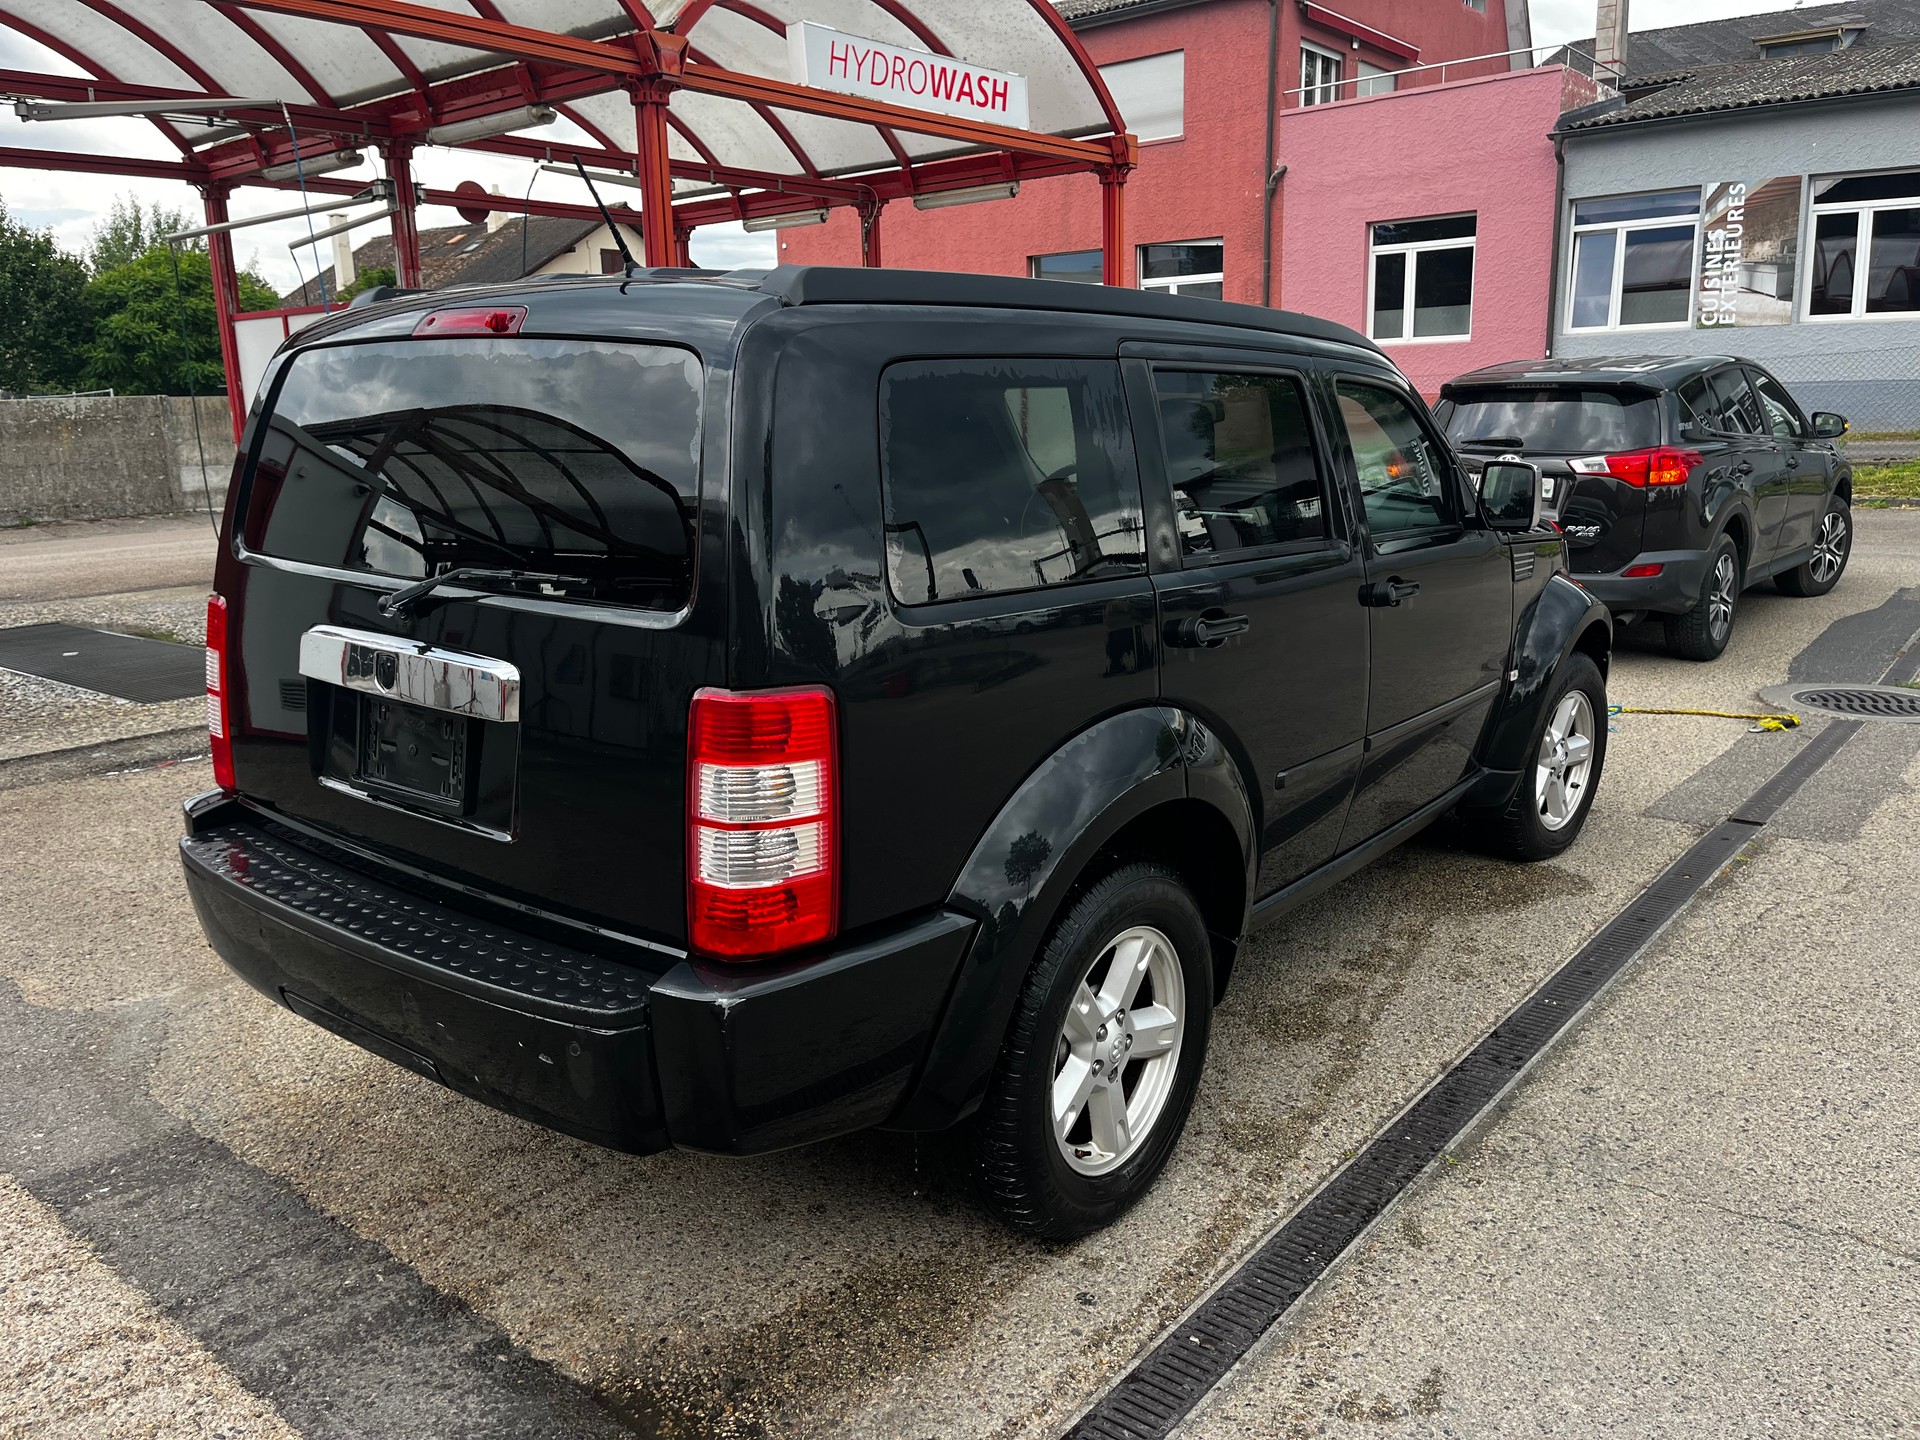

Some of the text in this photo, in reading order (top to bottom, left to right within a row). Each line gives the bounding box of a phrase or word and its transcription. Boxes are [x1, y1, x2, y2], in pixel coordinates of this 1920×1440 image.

[829, 40, 1009, 112] HYDROWASH
[1700, 228, 1726, 326] CUISINES
[1719, 183, 1746, 325] EXTERIEURES
